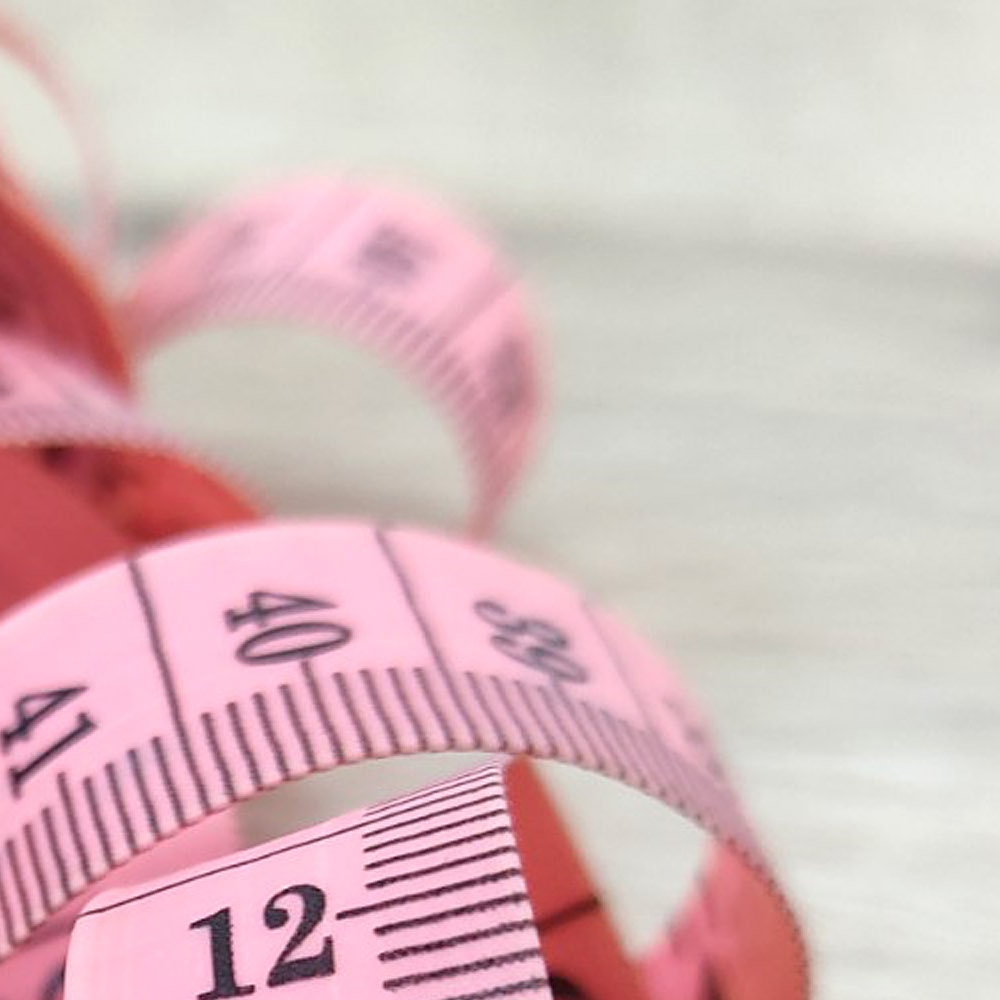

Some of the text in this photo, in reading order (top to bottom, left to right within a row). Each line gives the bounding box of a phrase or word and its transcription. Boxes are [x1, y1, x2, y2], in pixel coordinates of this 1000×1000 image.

[223, 590, 353, 666] 40
[474, 598, 590, 686] 39
[0, 682, 98, 798] 41
